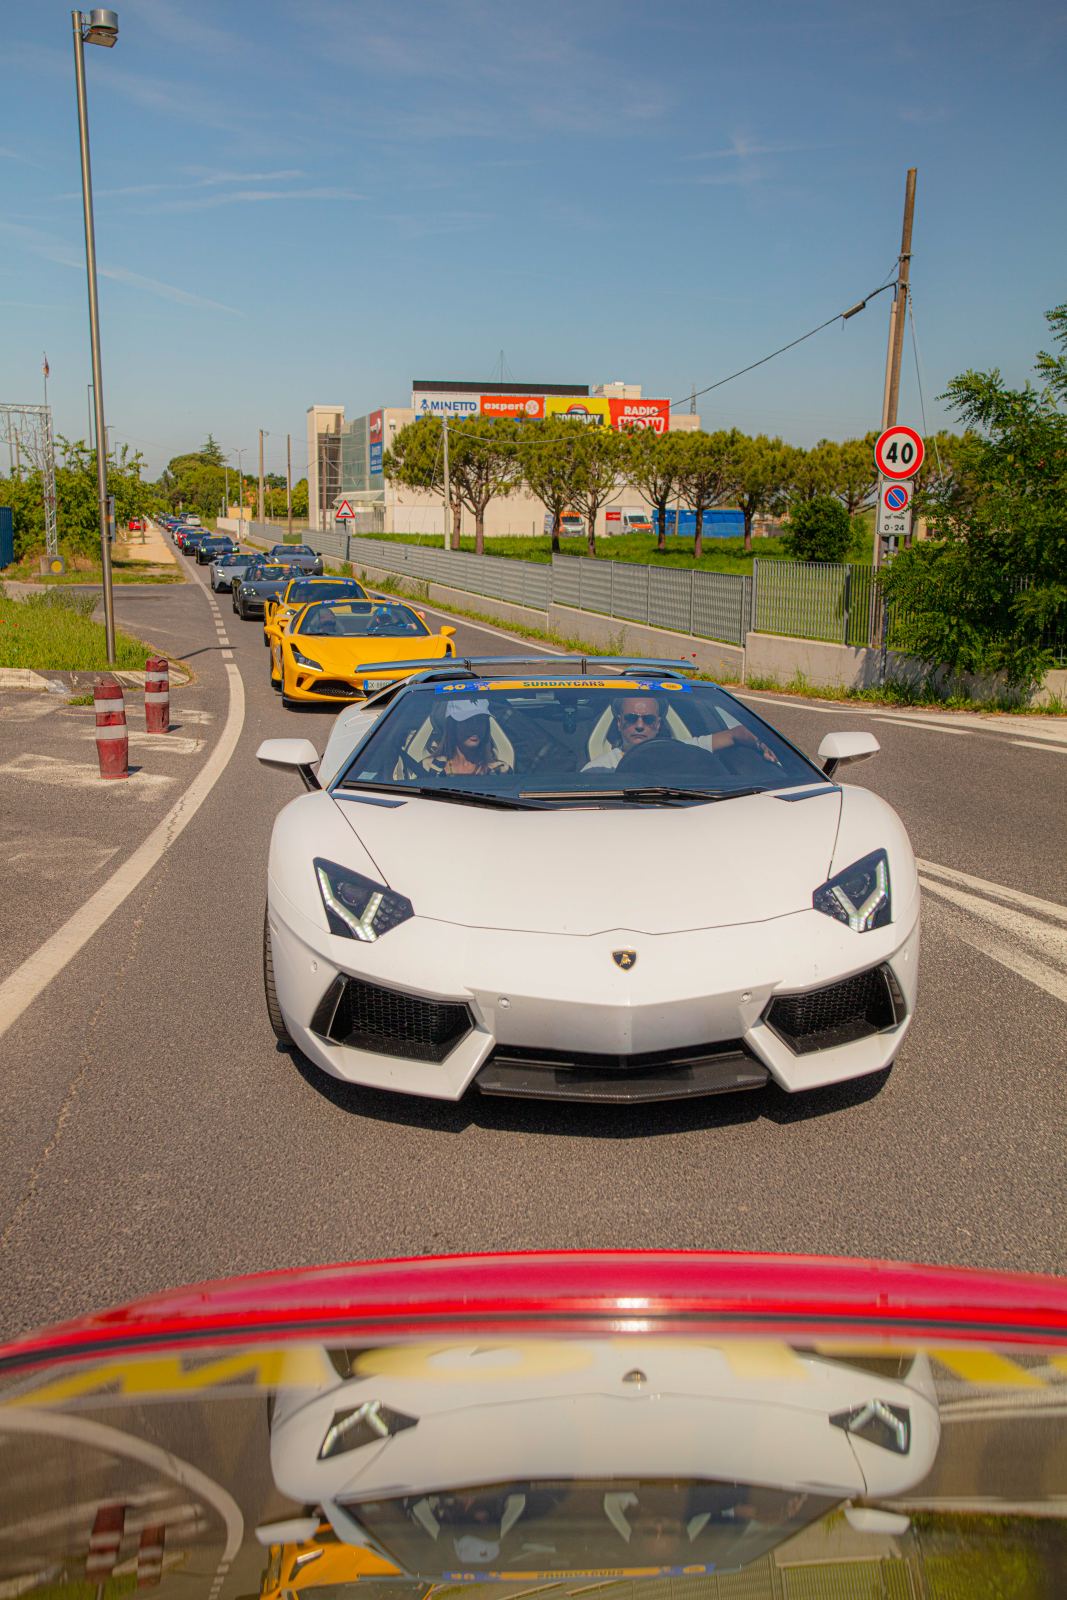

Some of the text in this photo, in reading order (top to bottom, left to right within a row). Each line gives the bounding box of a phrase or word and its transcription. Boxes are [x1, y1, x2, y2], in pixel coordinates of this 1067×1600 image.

[431, 401, 477, 411] MINETTO
[484, 402, 524, 411] expert
[624, 406, 659, 415] RADIO
[886, 442, 914, 464] 40
[443, 683, 466, 691] 40
[3, 1336, 1067, 1408] LLOW
